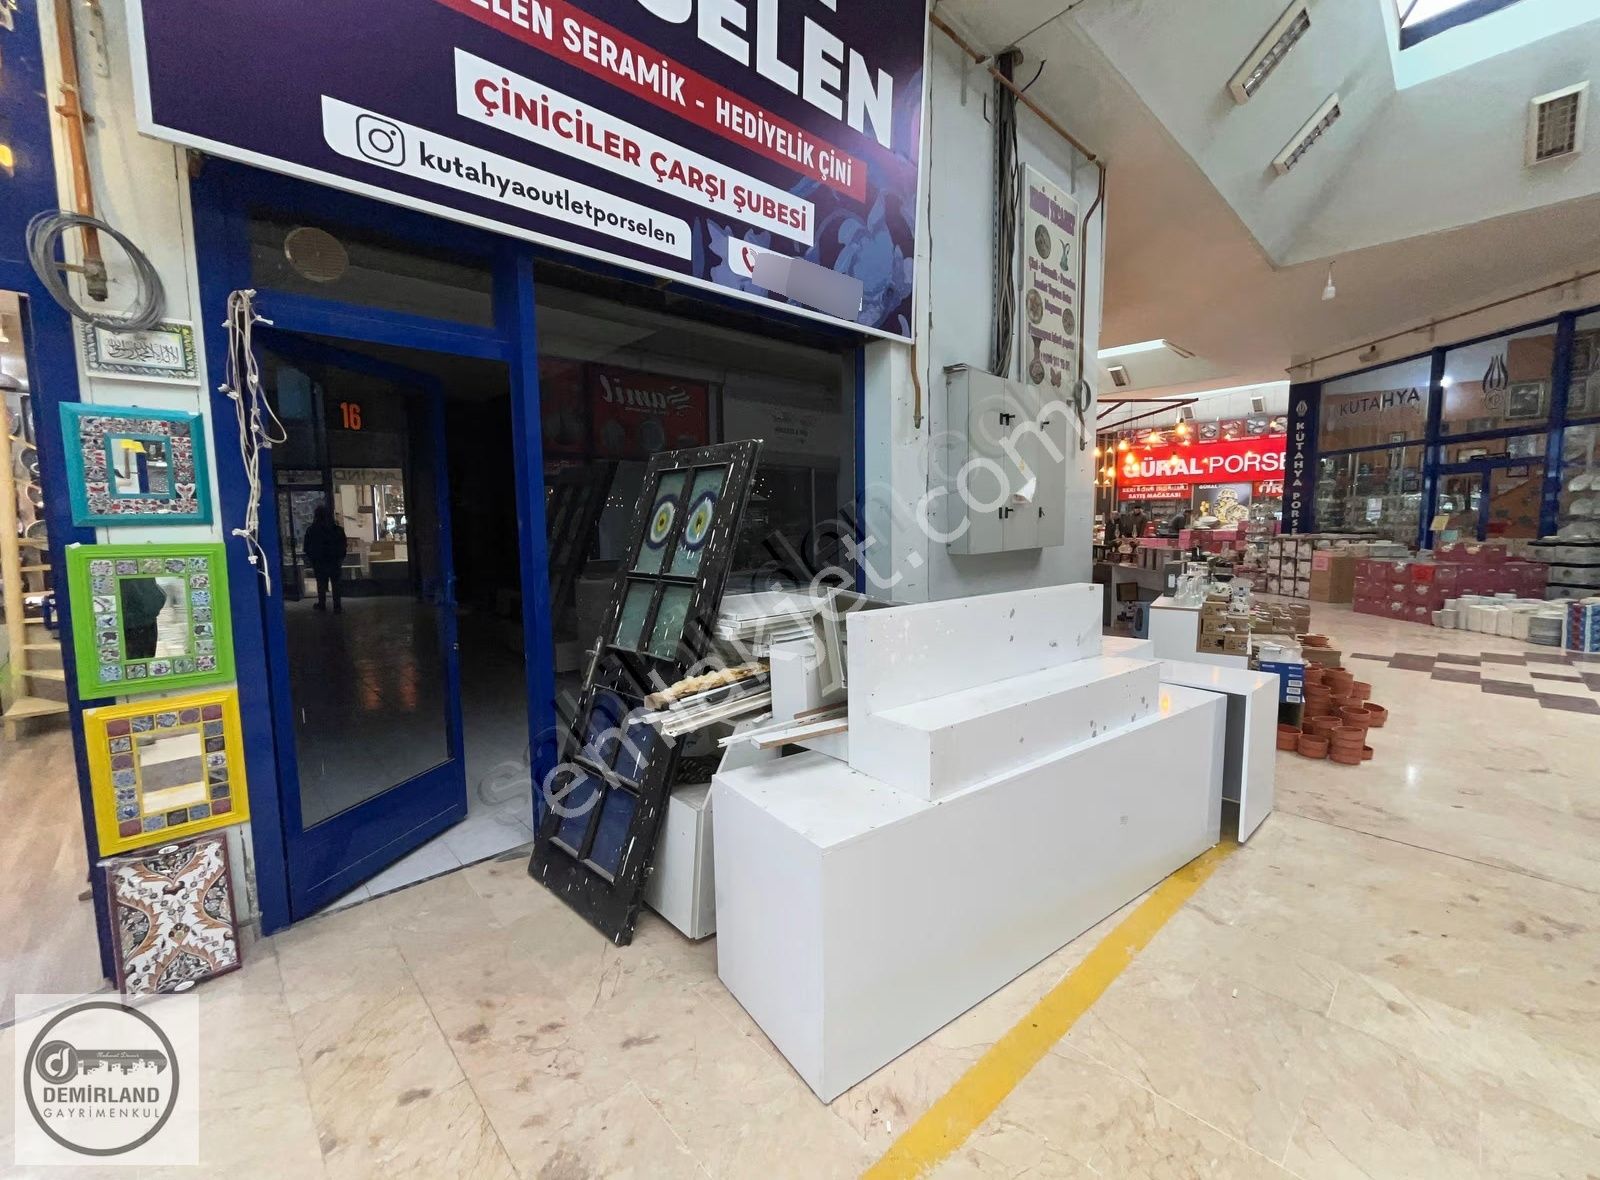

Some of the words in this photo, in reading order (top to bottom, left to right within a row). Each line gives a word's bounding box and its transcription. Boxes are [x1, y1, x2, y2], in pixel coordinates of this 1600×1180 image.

[563, 17, 686, 107] SERAMİK
[716, 96, 814, 169] HEDİYELİK
[819, 149, 852, 187] ÇİNİ
[636, 0, 893, 149] ELEN
[420, 141, 675, 246] kutahyaoutletporselen
[474, 77, 641, 168] ÇİNİCİLER
[650, 151, 725, 202] ÇARŞI
[733, 186, 807, 232] ŞUBESİ
[340, 402, 362, 430] 16
[1124, 456, 1203, 478] GÜRAL
[1293, 422, 1304, 487] KÜTAHYA
